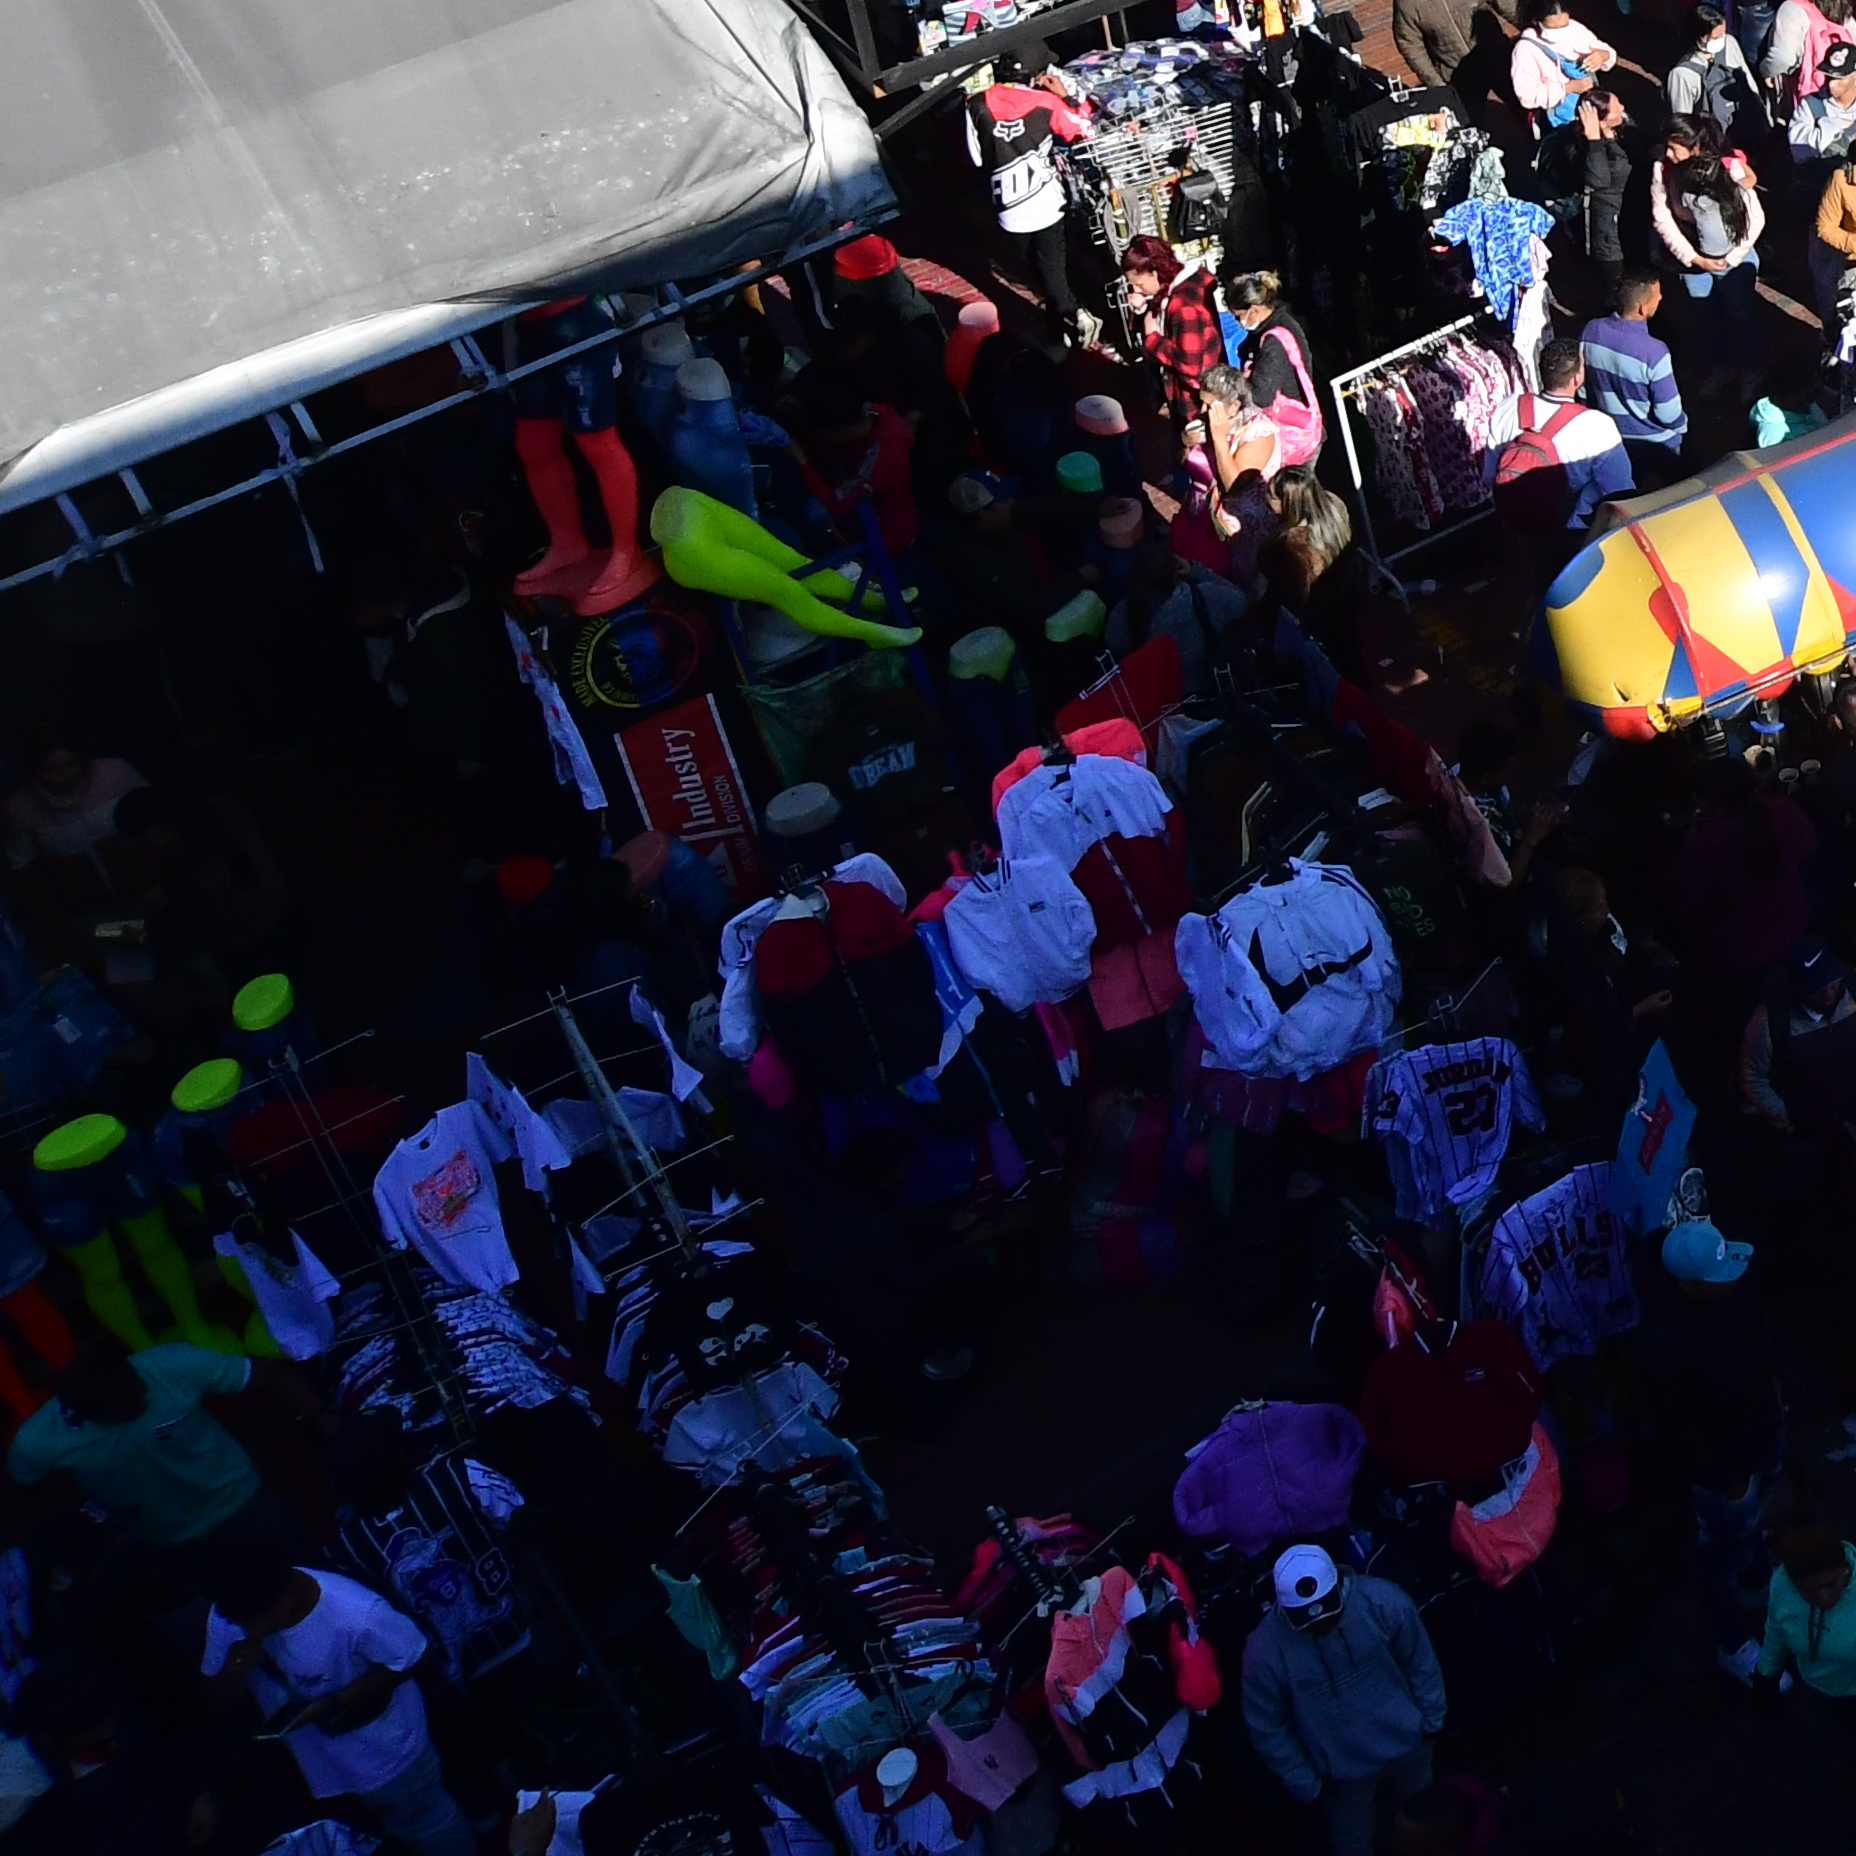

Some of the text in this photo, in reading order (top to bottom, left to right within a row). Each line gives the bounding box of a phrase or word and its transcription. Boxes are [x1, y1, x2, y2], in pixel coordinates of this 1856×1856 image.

[662, 727, 718, 840] Industry
[1422, 1056, 1515, 1095] JORDAN
[1443, 1082, 1497, 1137] 23
[1576, 1251, 1612, 1282] 23
